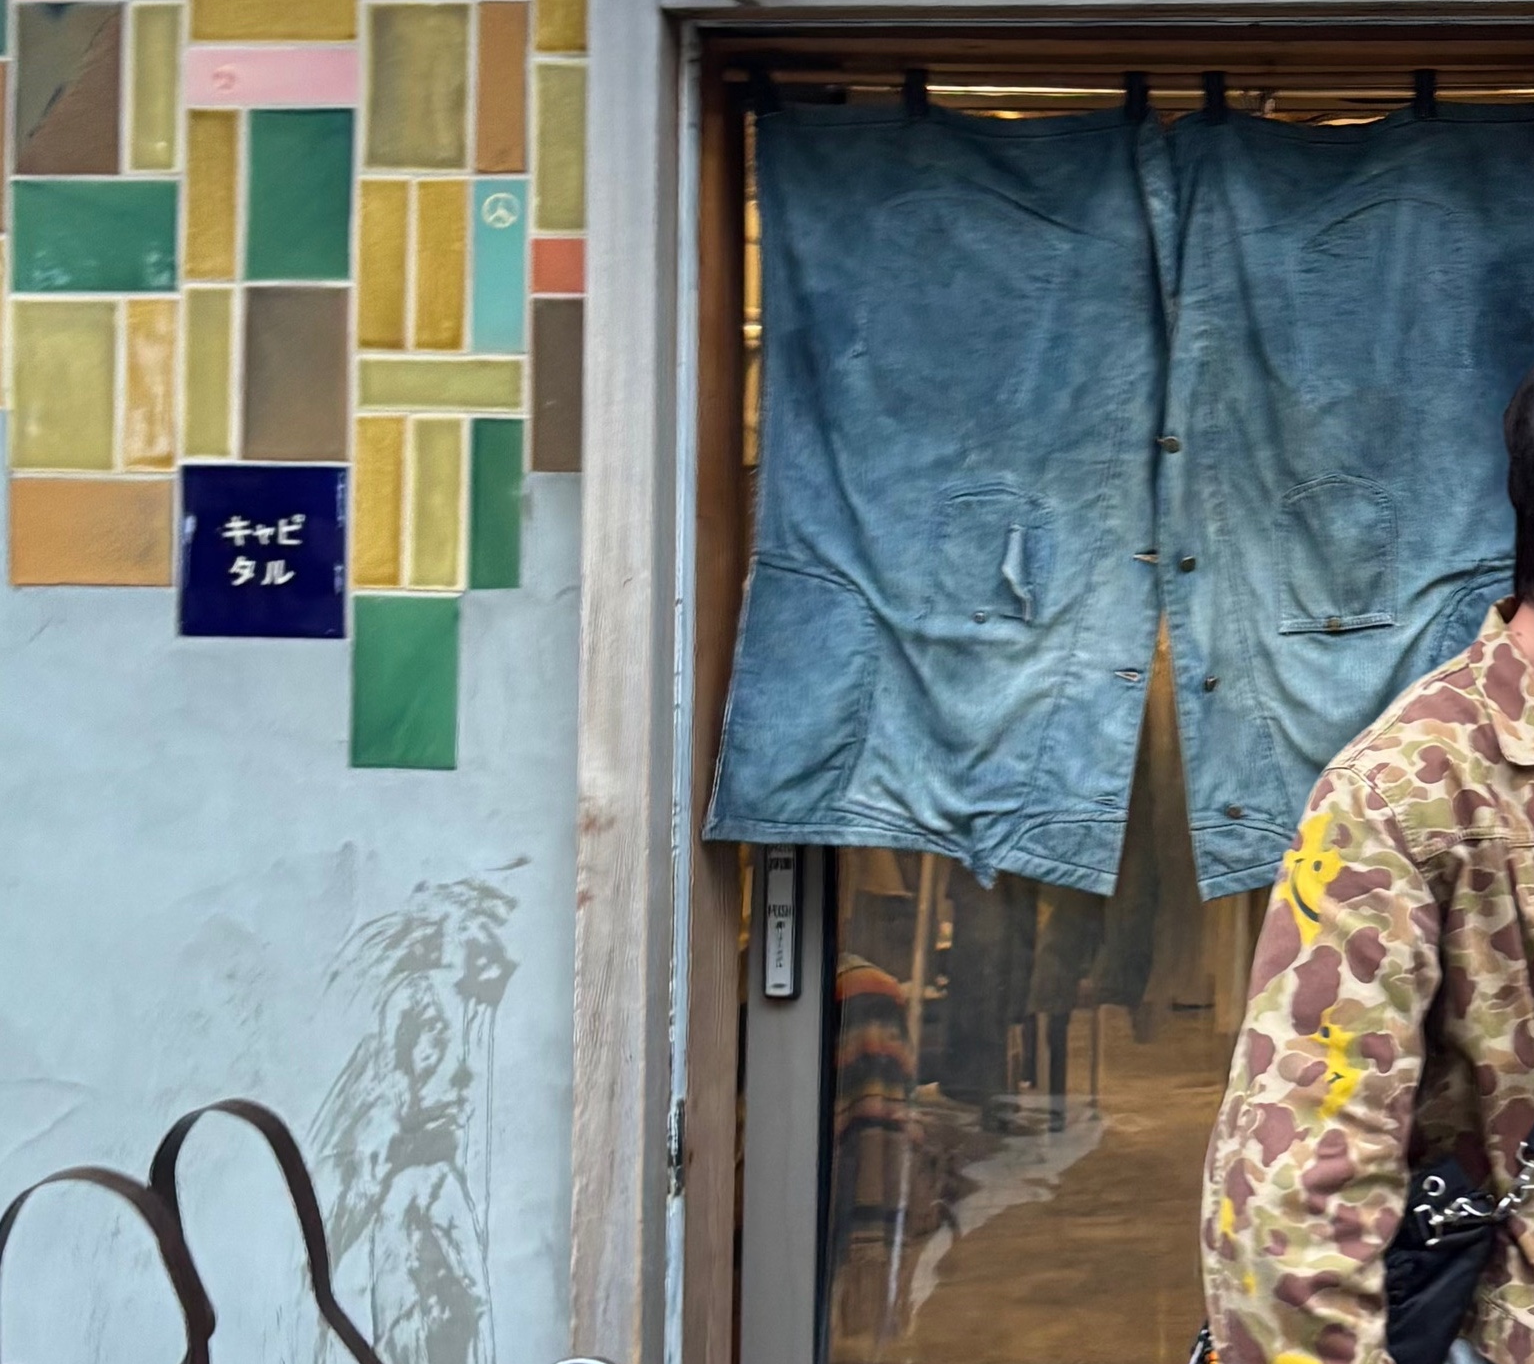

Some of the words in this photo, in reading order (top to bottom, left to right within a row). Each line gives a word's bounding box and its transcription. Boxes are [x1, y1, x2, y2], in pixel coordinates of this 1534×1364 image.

[222, 514, 306, 547] キャピ
[229, 555, 297, 586] タル
